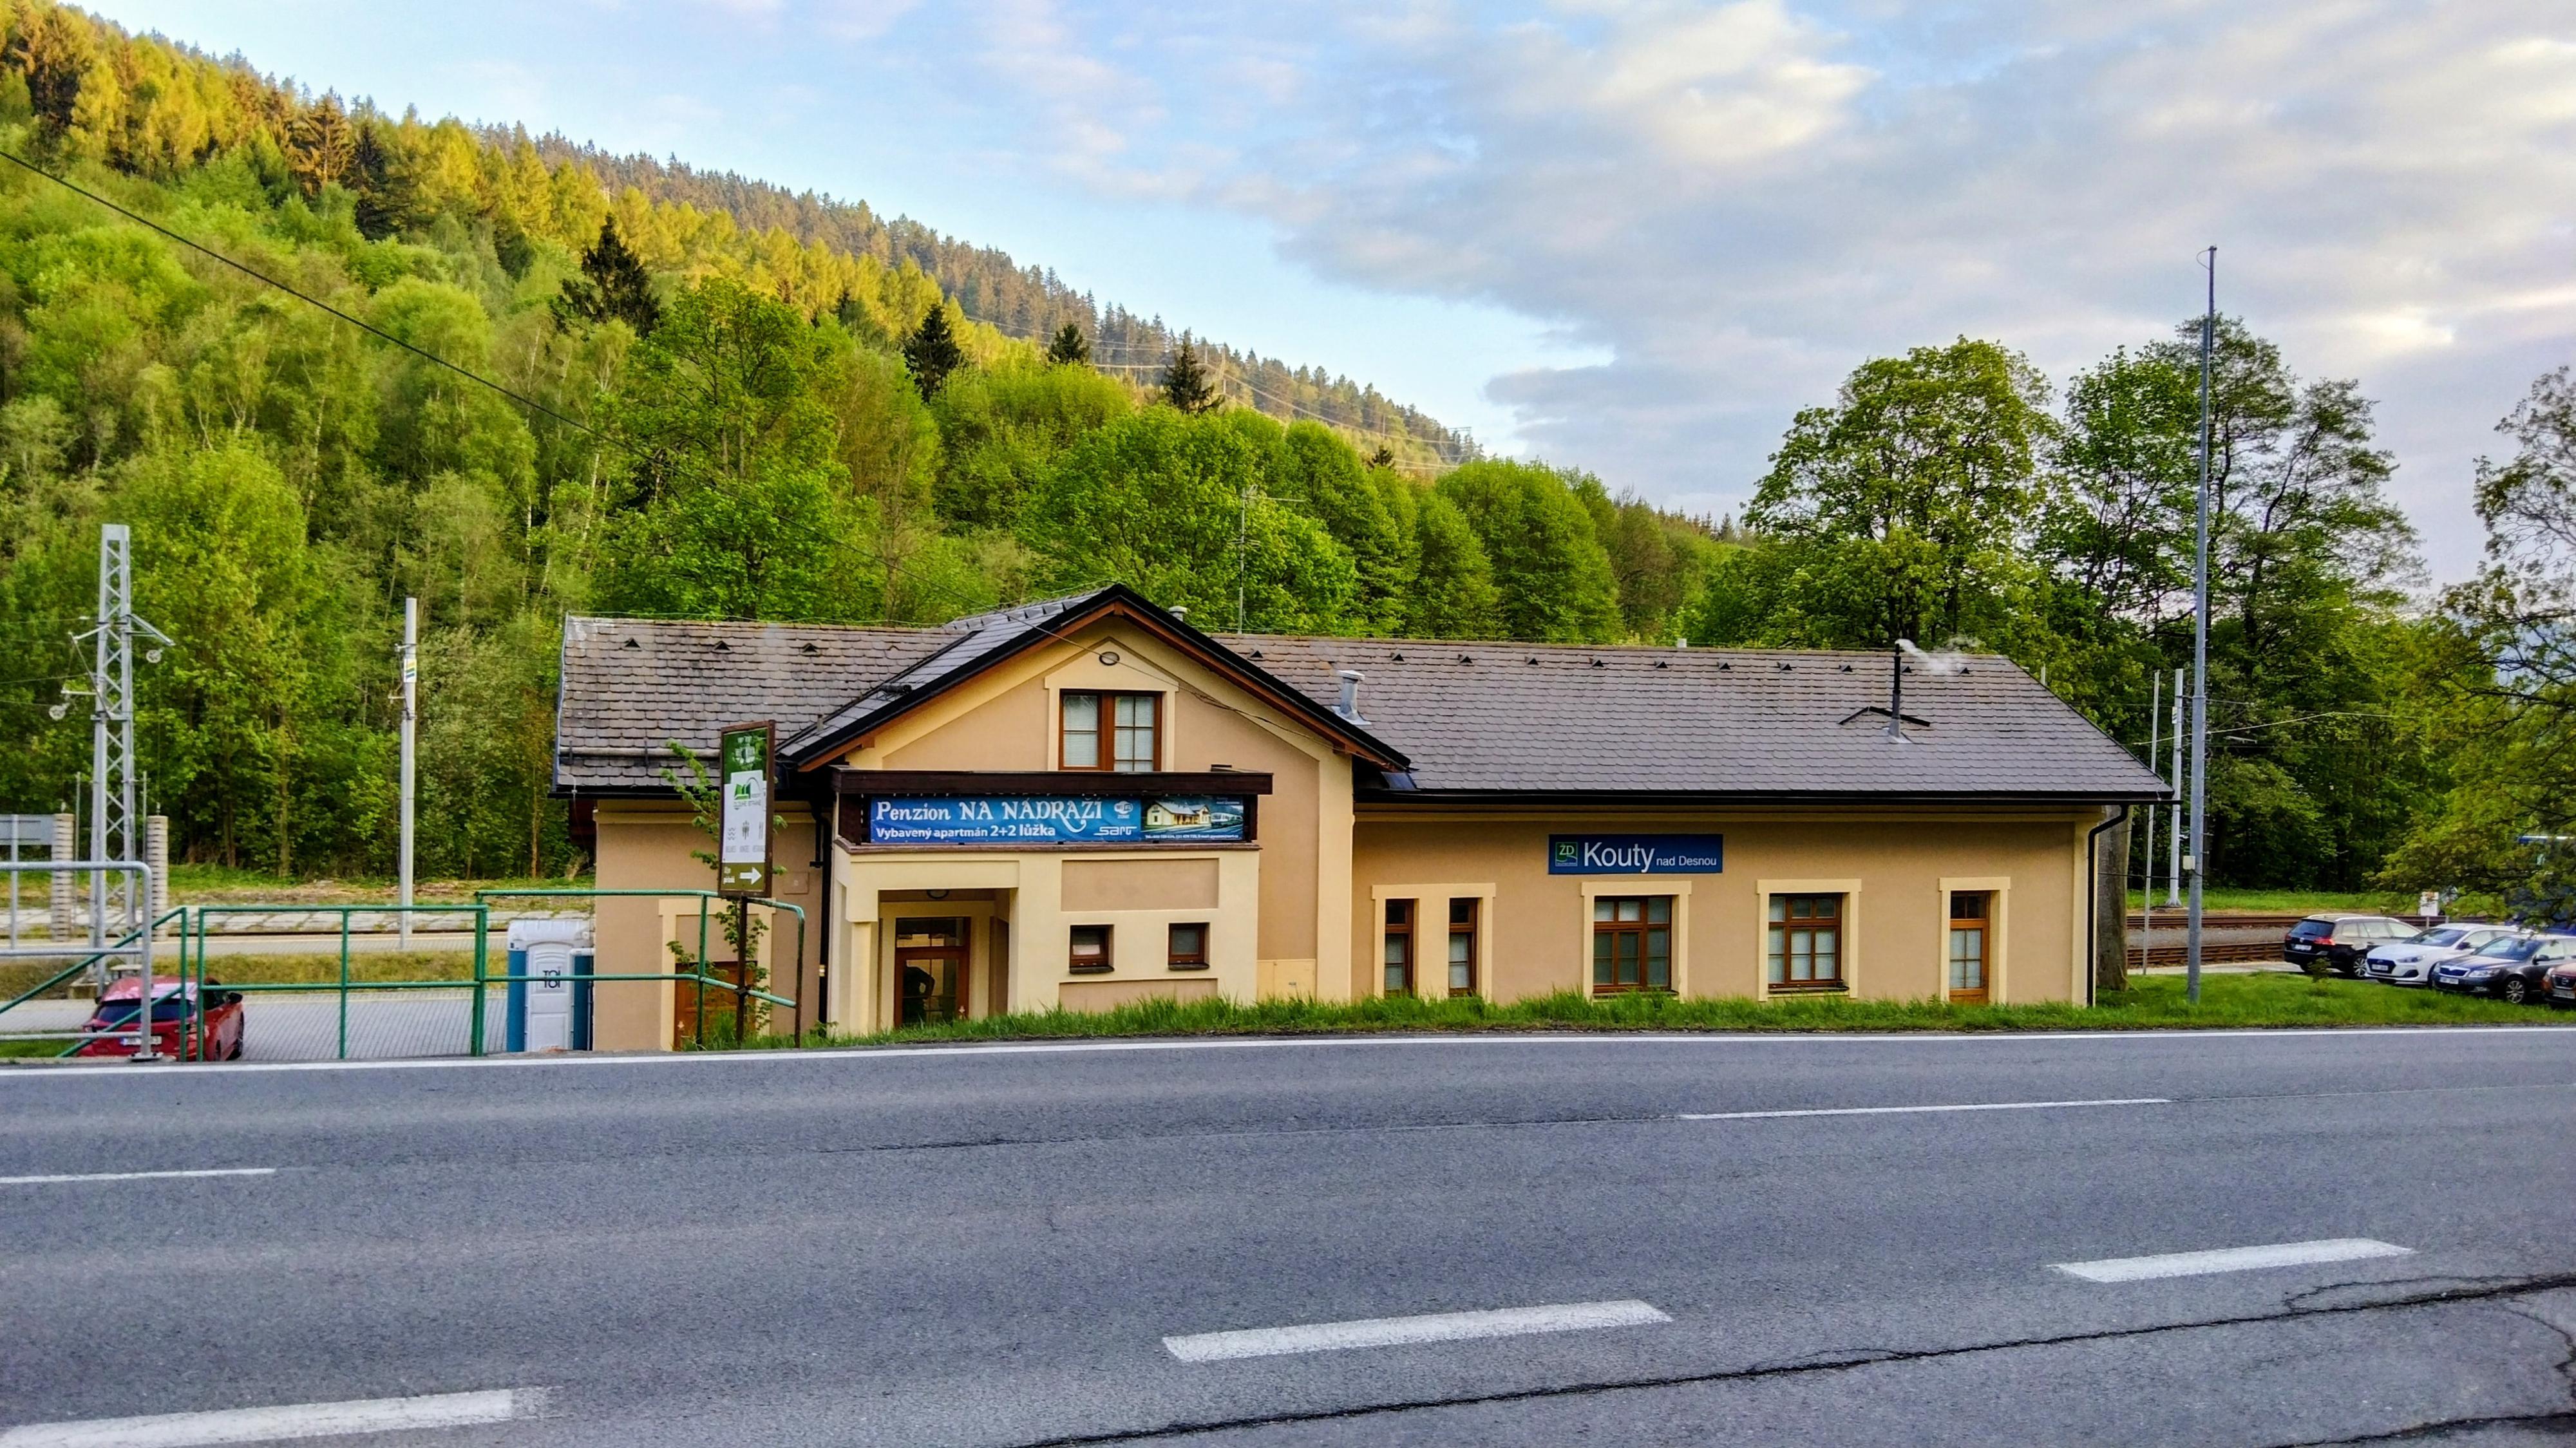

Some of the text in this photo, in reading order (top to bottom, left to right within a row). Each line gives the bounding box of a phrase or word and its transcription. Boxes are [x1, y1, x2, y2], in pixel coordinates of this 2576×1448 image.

[876, 797, 1103, 832] Penzion NA NÁDRAŽÍ
[876, 823, 1056, 840] Vybavený apartmán 2+2 lůžka
[1584, 842, 1717, 873] Kouty nad Desnou
